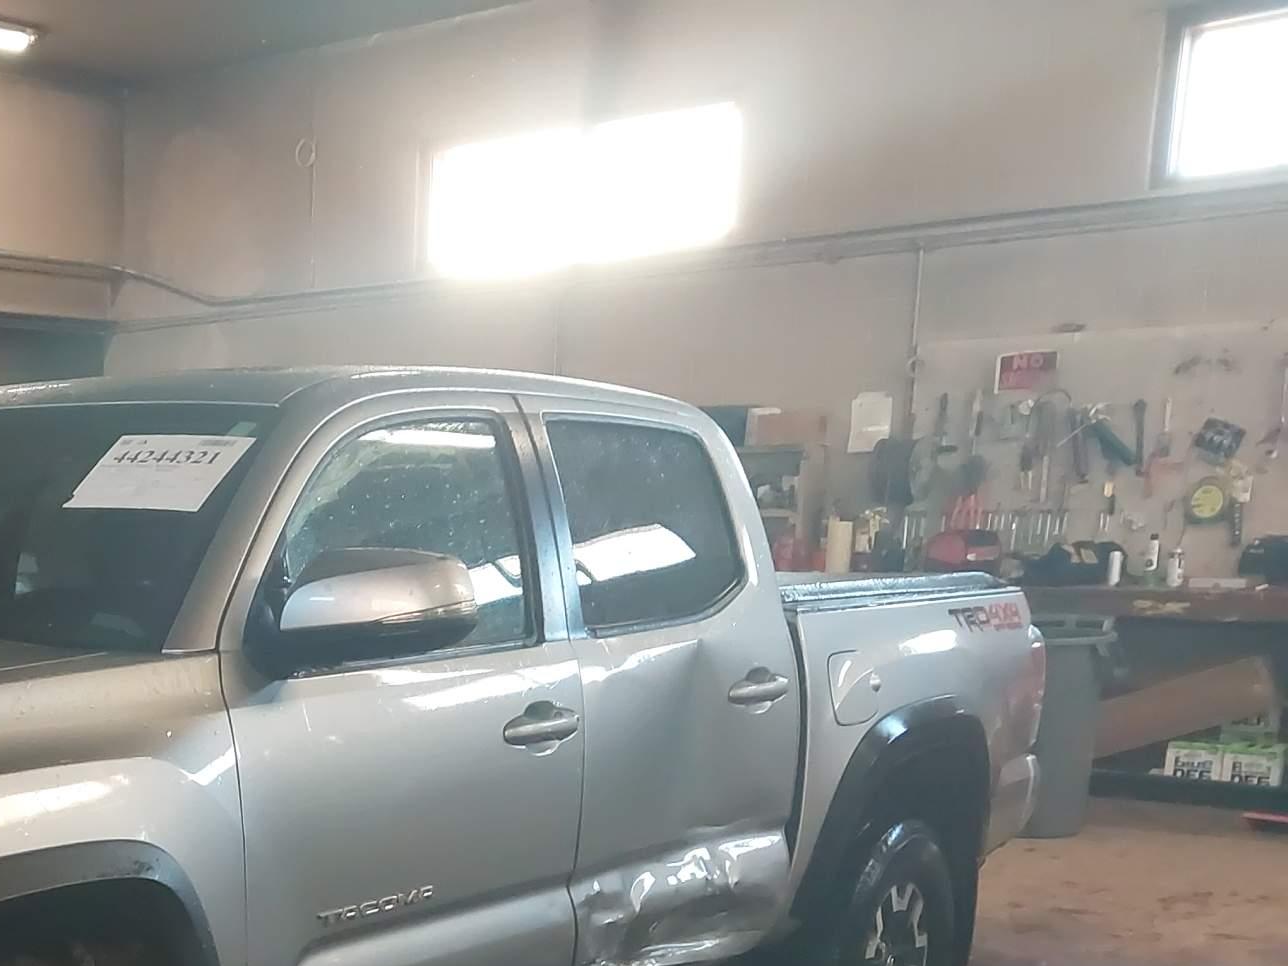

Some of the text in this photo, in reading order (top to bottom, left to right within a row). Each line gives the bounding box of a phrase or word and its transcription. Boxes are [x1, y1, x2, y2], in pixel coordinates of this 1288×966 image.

[1012, 353, 1044, 370] NO
[113, 450, 221, 464] 44244321
[948, 606, 990, 632] TRD
[316, 885, 433, 925] TACOMA
